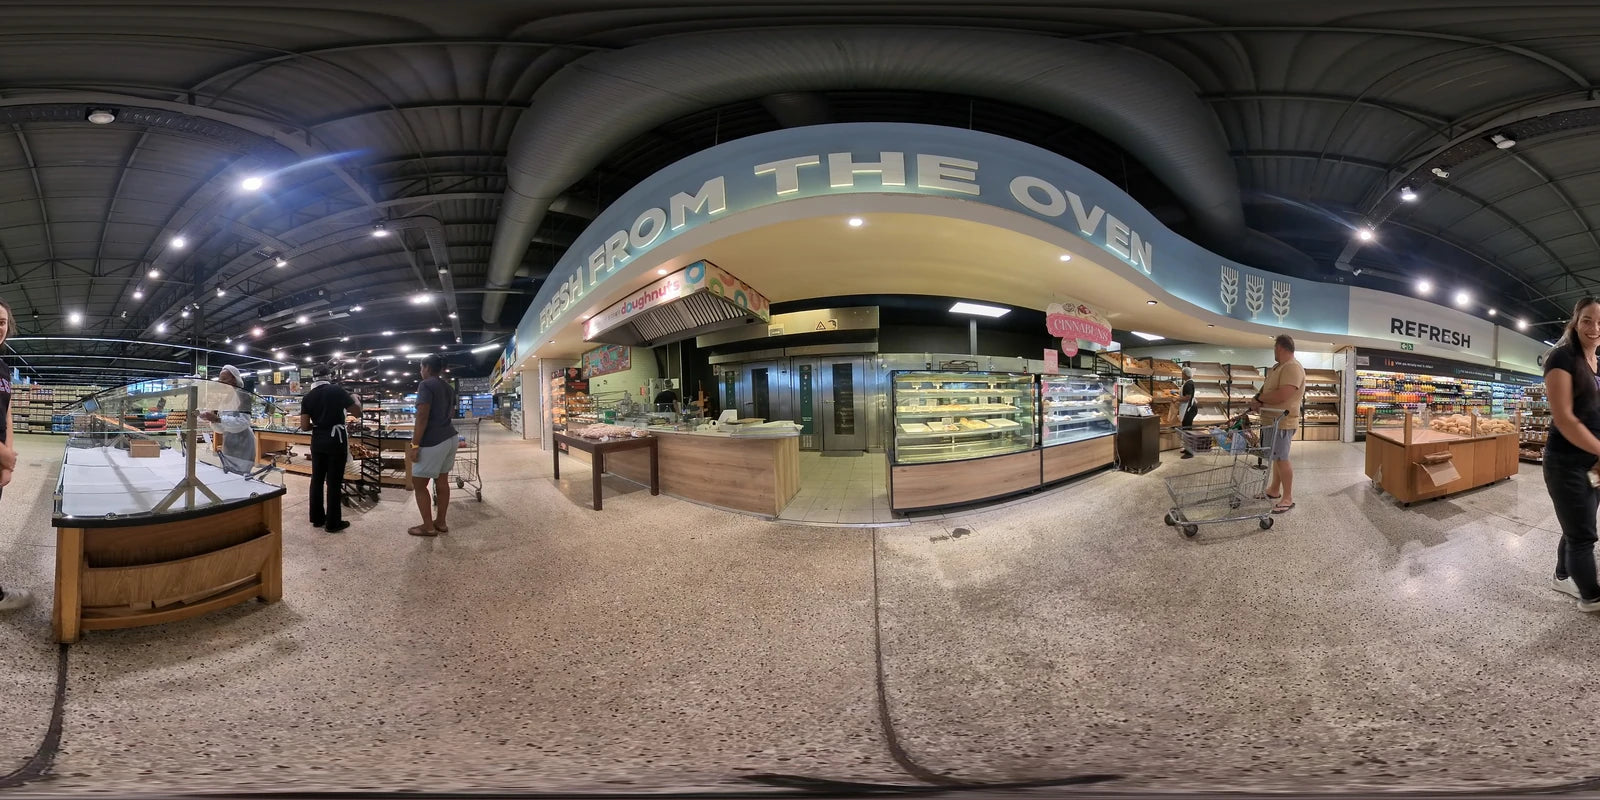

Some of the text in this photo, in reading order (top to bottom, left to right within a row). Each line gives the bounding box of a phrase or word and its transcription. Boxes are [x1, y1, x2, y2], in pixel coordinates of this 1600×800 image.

[540, 151, 1152, 334] FRESH FROM THE OVEN
[620, 280, 681, 315] doughnuts
[1054, 319, 1108, 341] CINNABUNS
[1391, 317, 1471, 348] REFRESH
